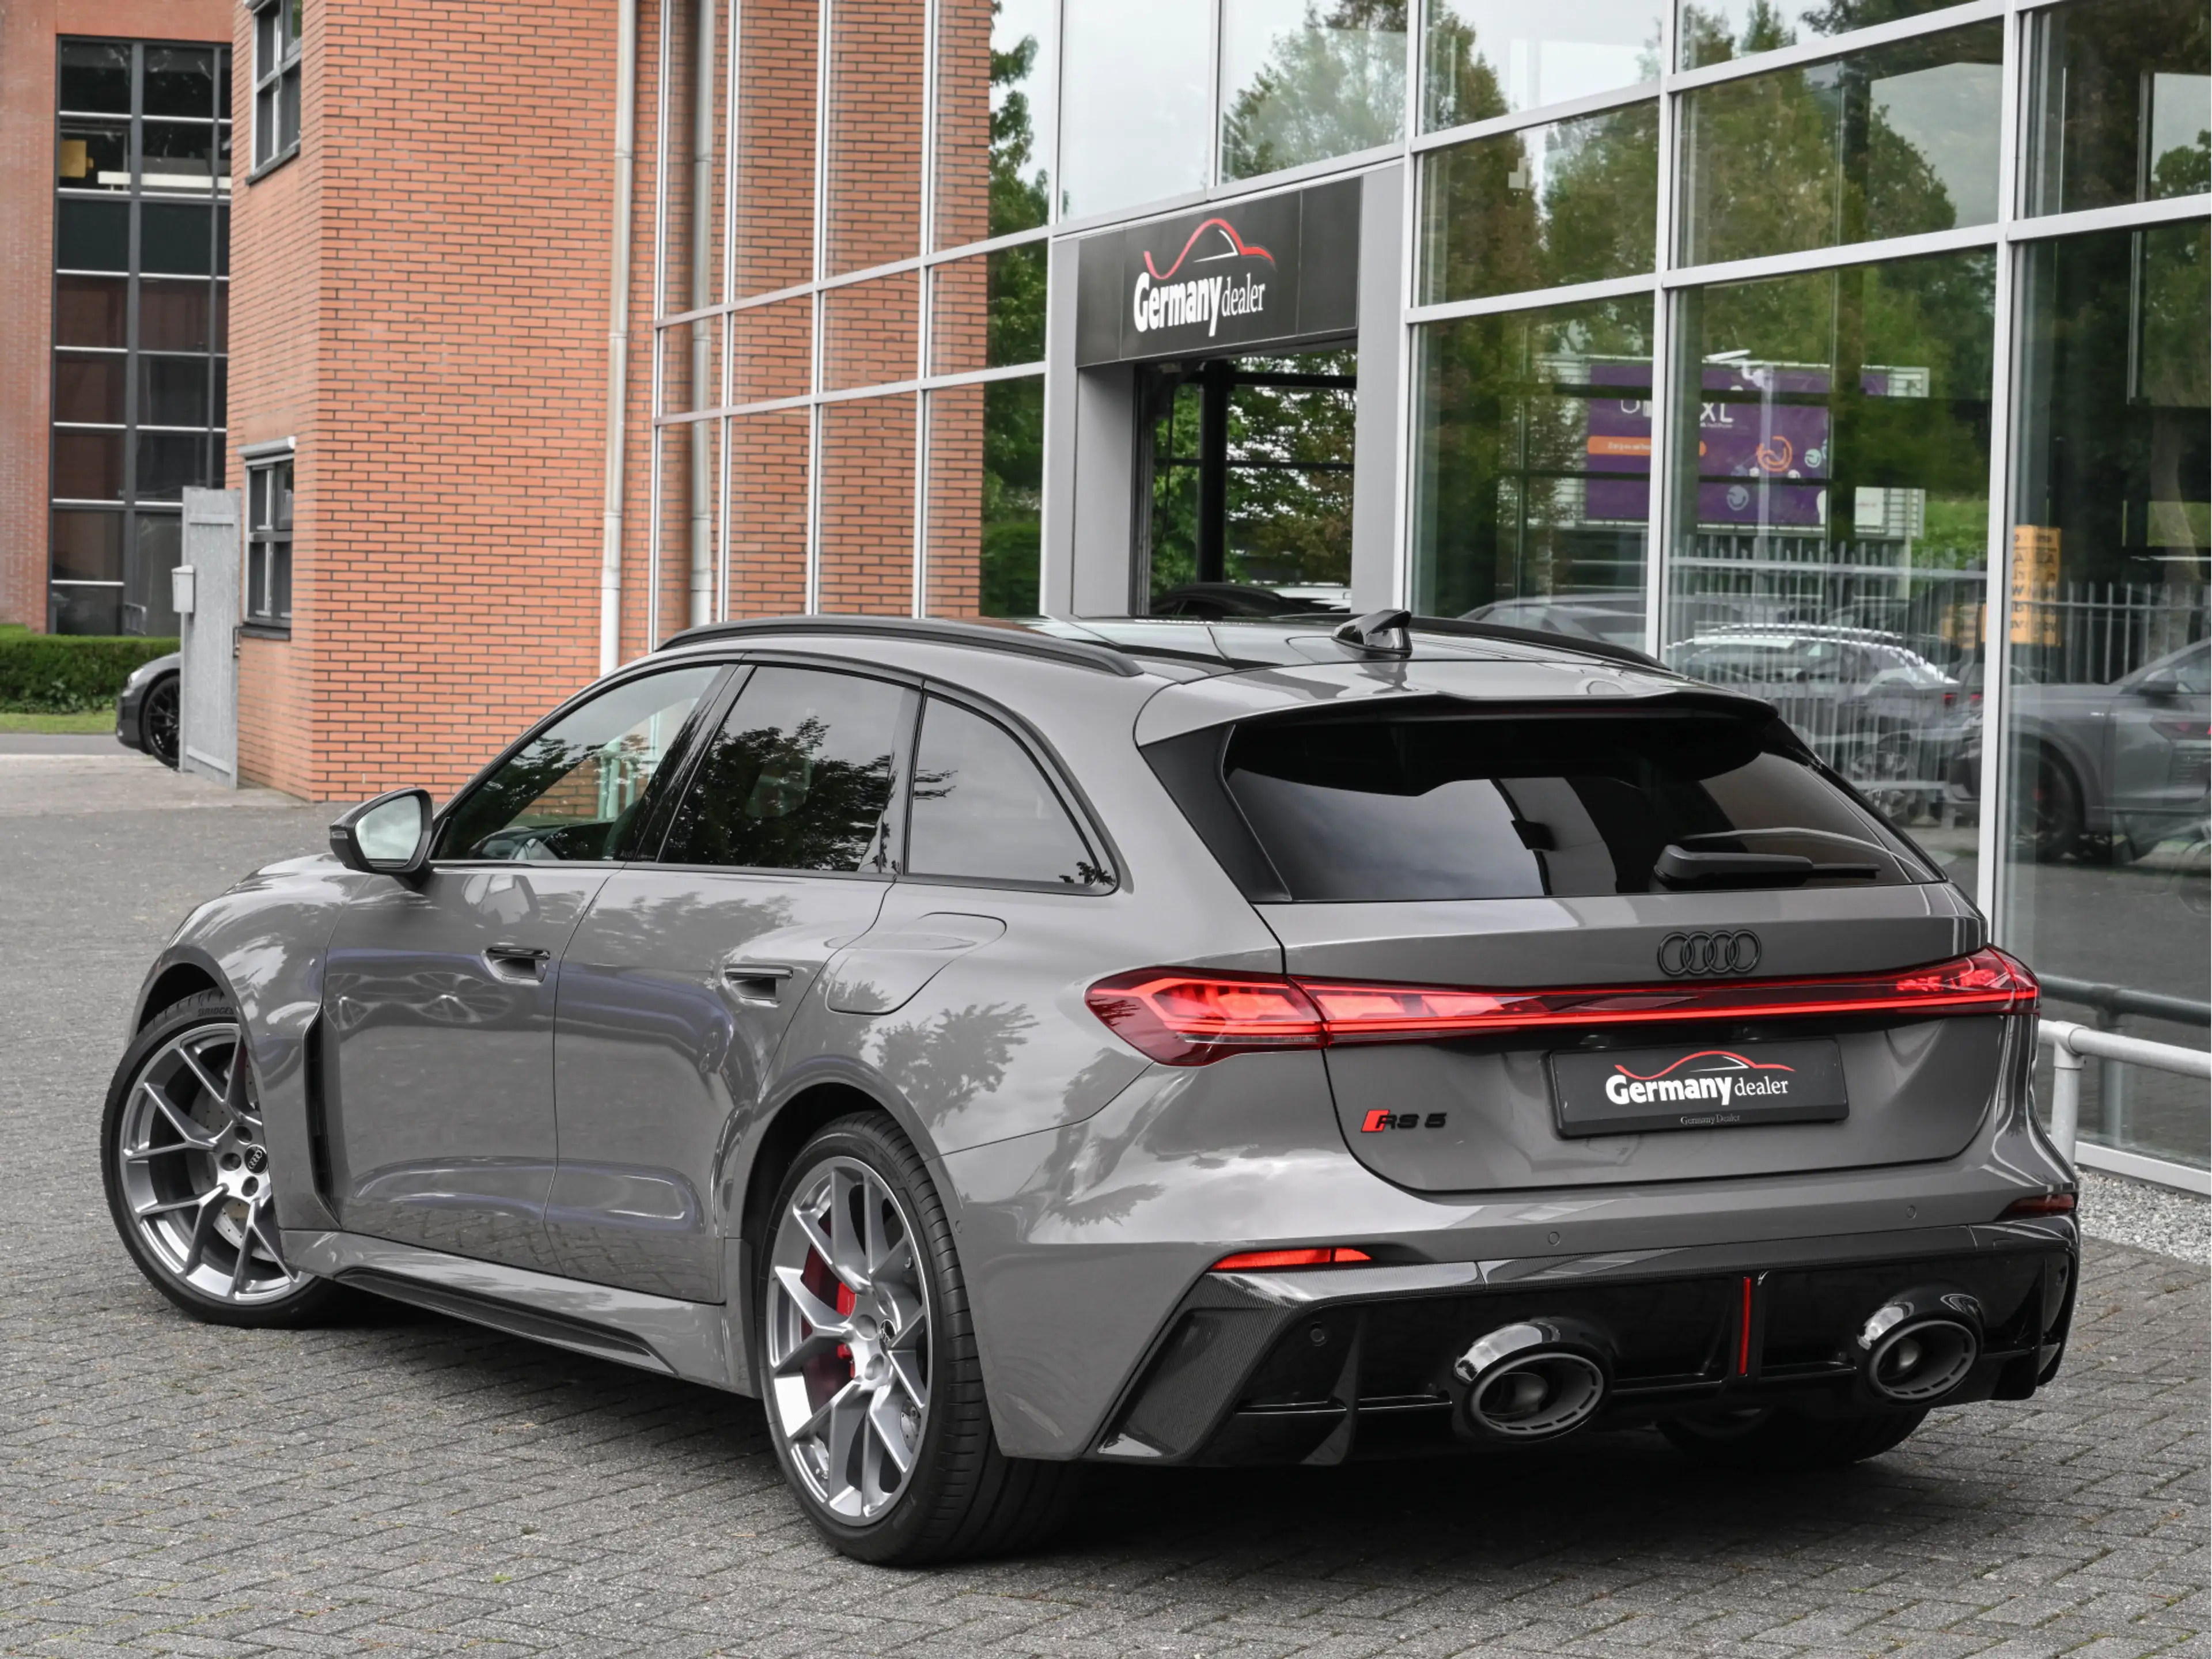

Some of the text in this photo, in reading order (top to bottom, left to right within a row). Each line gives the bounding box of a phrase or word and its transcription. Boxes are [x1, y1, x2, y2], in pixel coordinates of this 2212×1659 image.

[1133, 272, 1266, 336] Germany dealer
[1605, 1075, 1789, 1105] Germany dealer
[1374, 1112, 1448, 1130] RS 5
[1680, 1113, 1740, 1125] Germany Dealer
